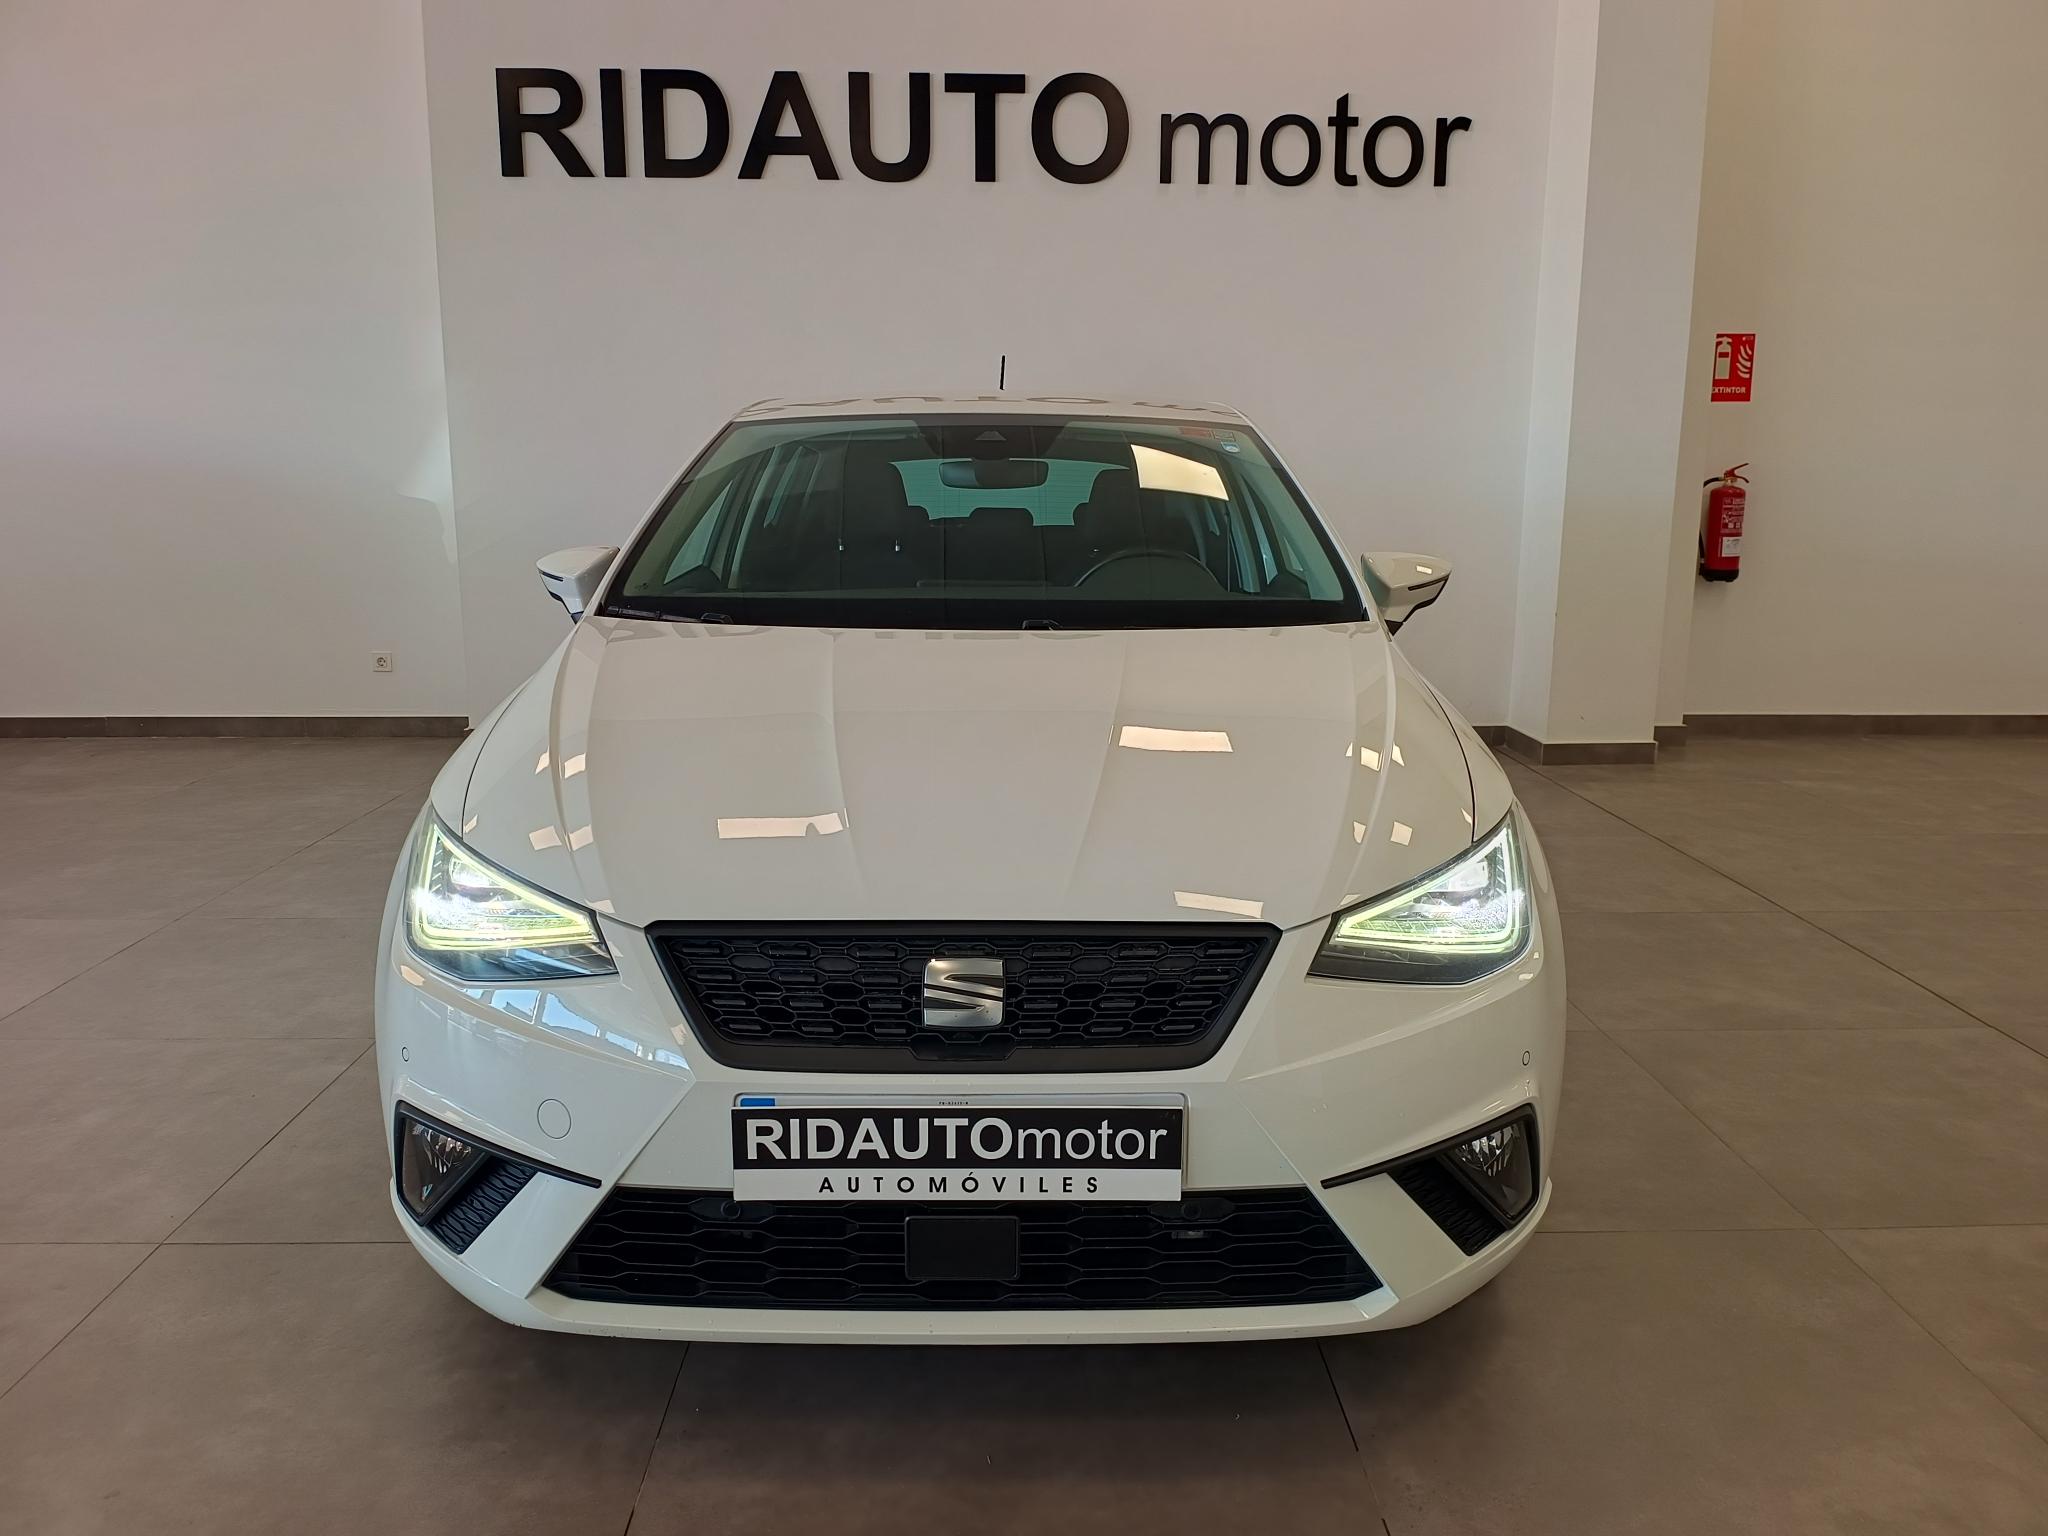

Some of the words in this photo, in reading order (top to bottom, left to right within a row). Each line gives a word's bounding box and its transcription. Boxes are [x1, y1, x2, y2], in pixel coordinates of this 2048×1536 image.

[496, 68, 1129, 184] RIDAUTO
[1160, 93, 1473, 187] motor
[746, 1117, 1168, 1160] RIDAUTOmotor
[818, 1172, 1099, 1194] AUTOMÓVILES
